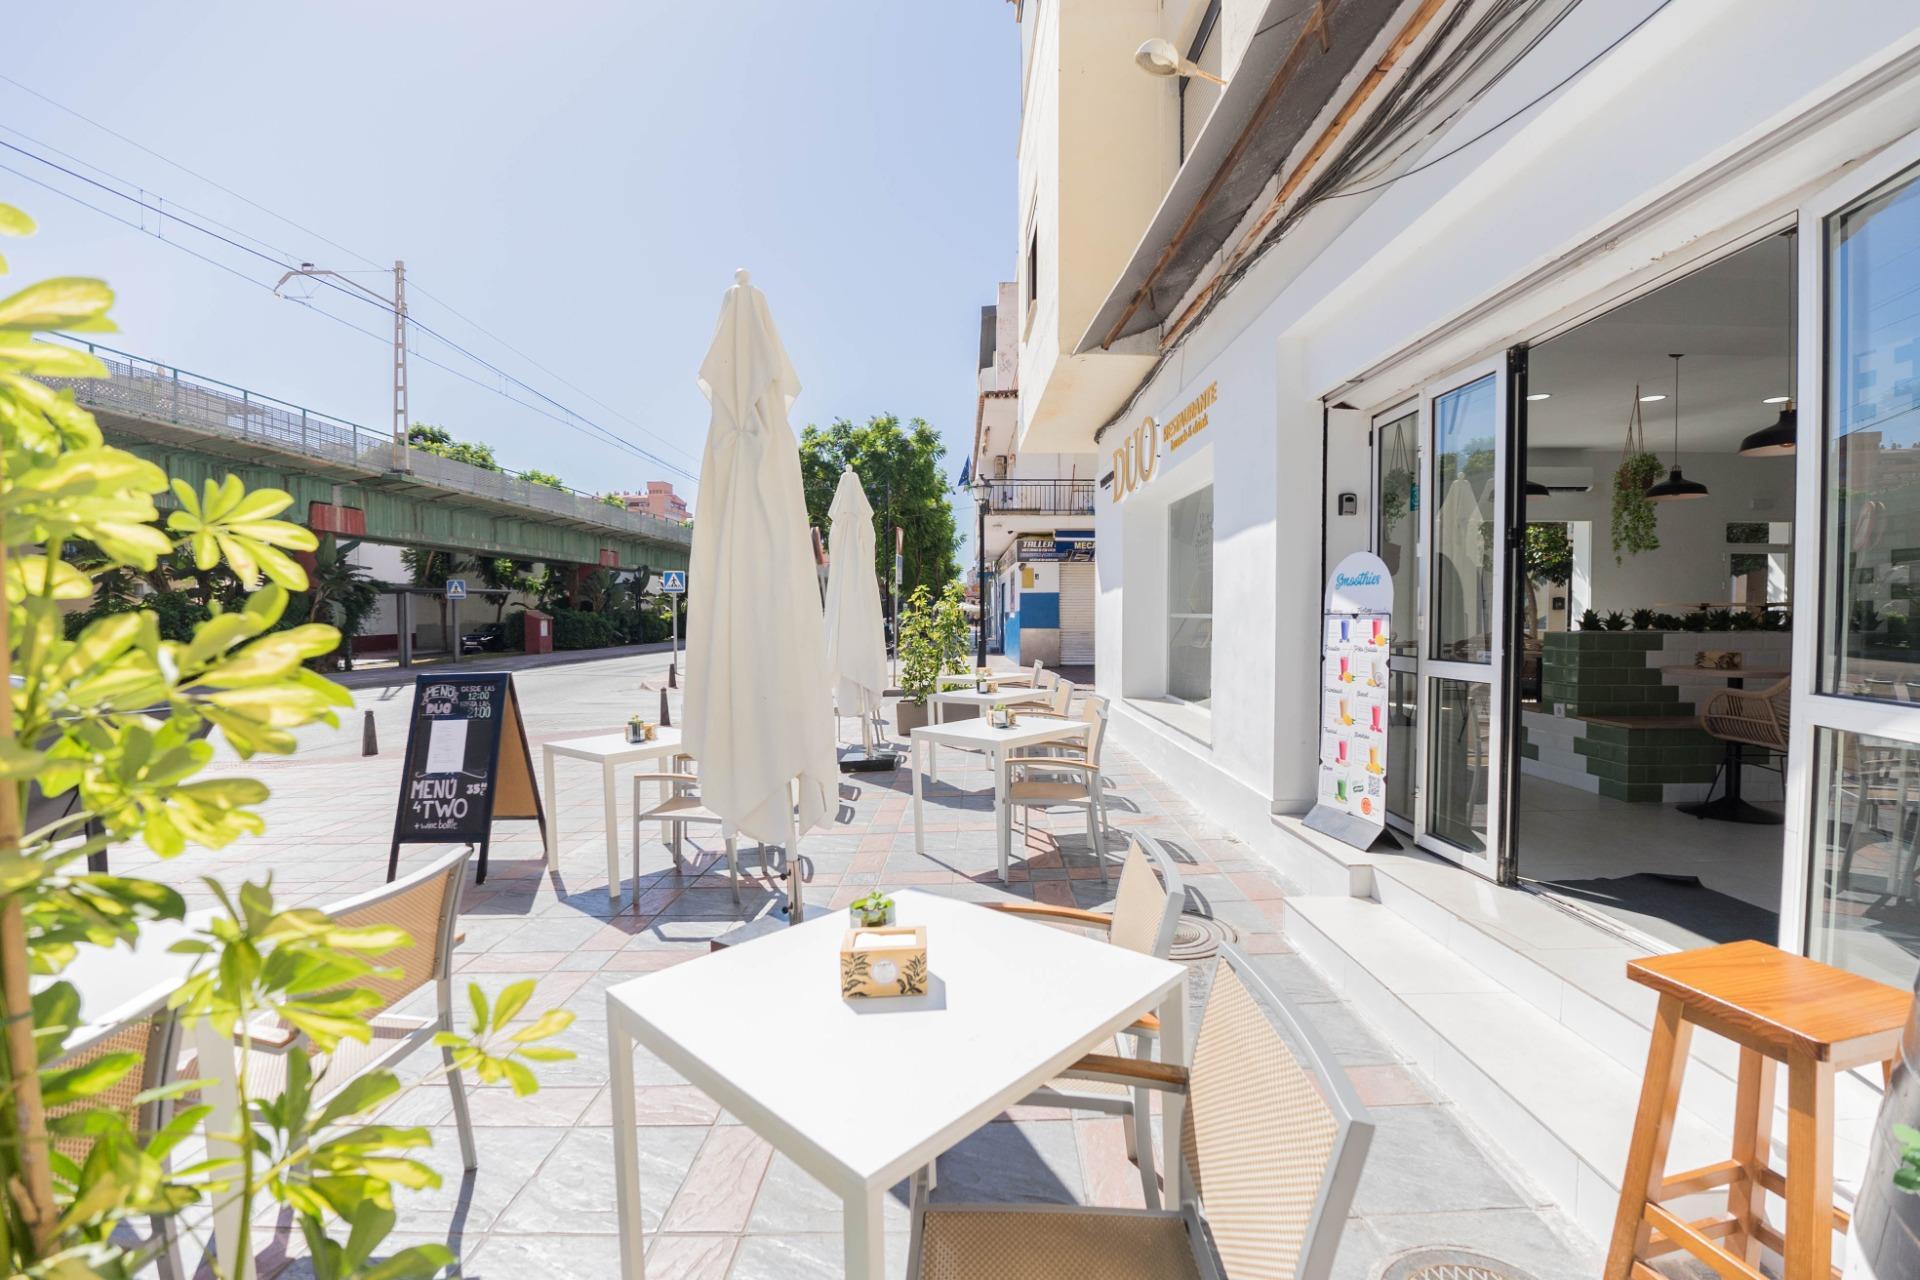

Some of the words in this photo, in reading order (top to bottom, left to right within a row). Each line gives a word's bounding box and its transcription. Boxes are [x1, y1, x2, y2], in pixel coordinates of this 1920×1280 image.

[1163, 380, 1217, 442] RESTAURANTE
[1335, 571, 1381, 590] Smoothies
[468, 692, 490, 700] 12:00
[467, 706, 491, 718] 21:00
[412, 801, 422, 813] 4
[422, 798, 468, 819] TWO
